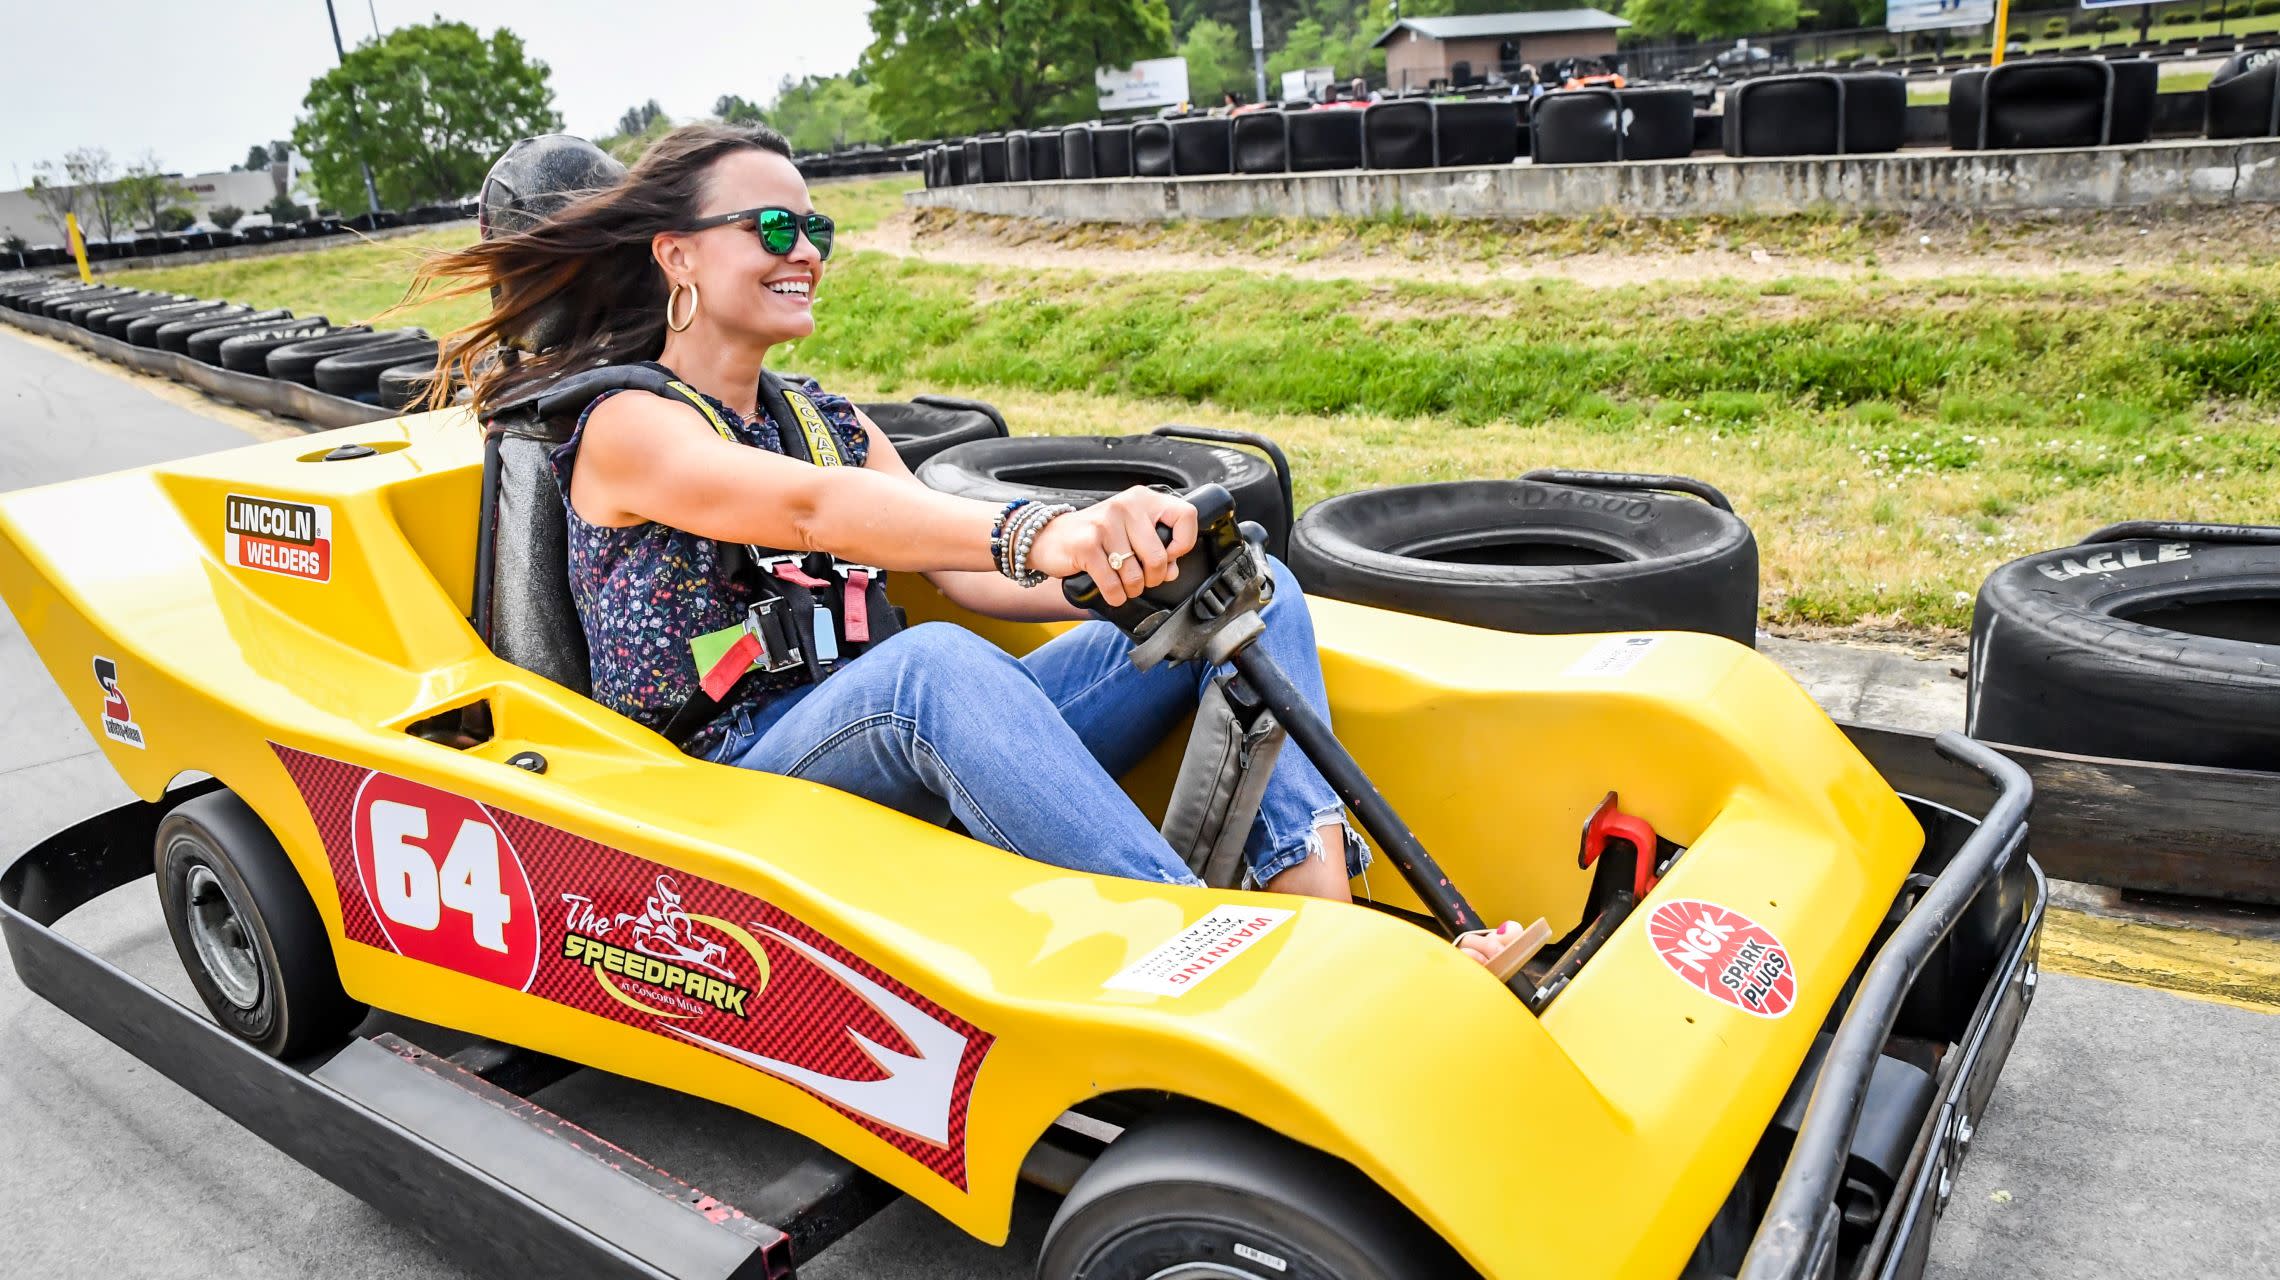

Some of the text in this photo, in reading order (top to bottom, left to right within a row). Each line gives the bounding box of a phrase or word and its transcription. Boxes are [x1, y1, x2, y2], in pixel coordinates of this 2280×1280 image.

[230, 501, 311, 541] LINCOLN
[246, 541, 320, 575] WELDERS
[2037, 542, 2192, 581] EAGLE
[369, 799, 512, 955] 64
[561, 893, 614, 937] The
[1169, 916, 1273, 985] WARNING
[1670, 910, 1736, 974] NGK
[1722, 939, 1766, 989] SPARK
[564, 934, 748, 1018] SPEEDPARK
[1744, 953, 1785, 1007] PLUGS
